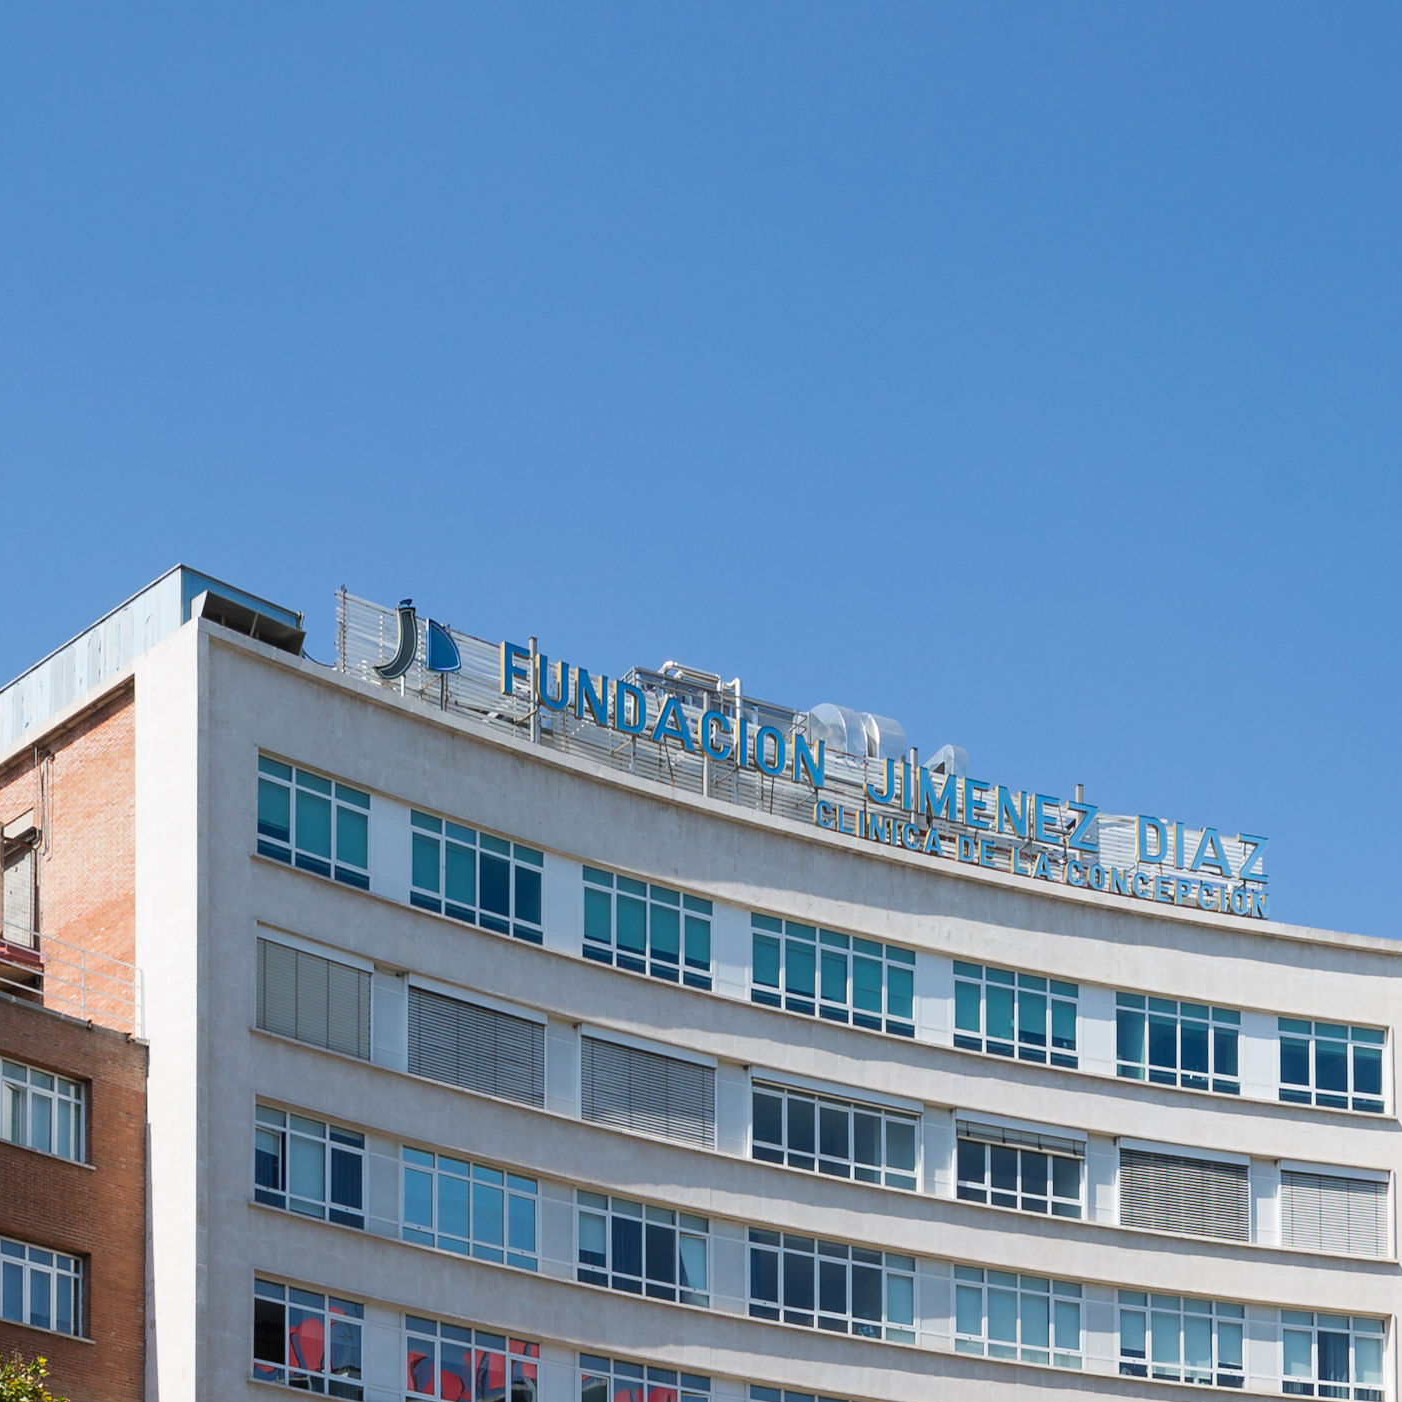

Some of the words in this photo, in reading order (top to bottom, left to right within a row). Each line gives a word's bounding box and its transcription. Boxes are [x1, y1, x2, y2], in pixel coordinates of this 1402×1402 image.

[499, 640, 826, 789] FUNDACION
[863, 757, 1099, 853] JIMENEZ
[1135, 814, 1270, 884] DIAZ
[813, 800, 944, 858] CLINICA
[955, 834, 996, 868] DE
[1011, 846, 1053, 881] LA
[1065, 859, 1270, 920] CONCEPCION
